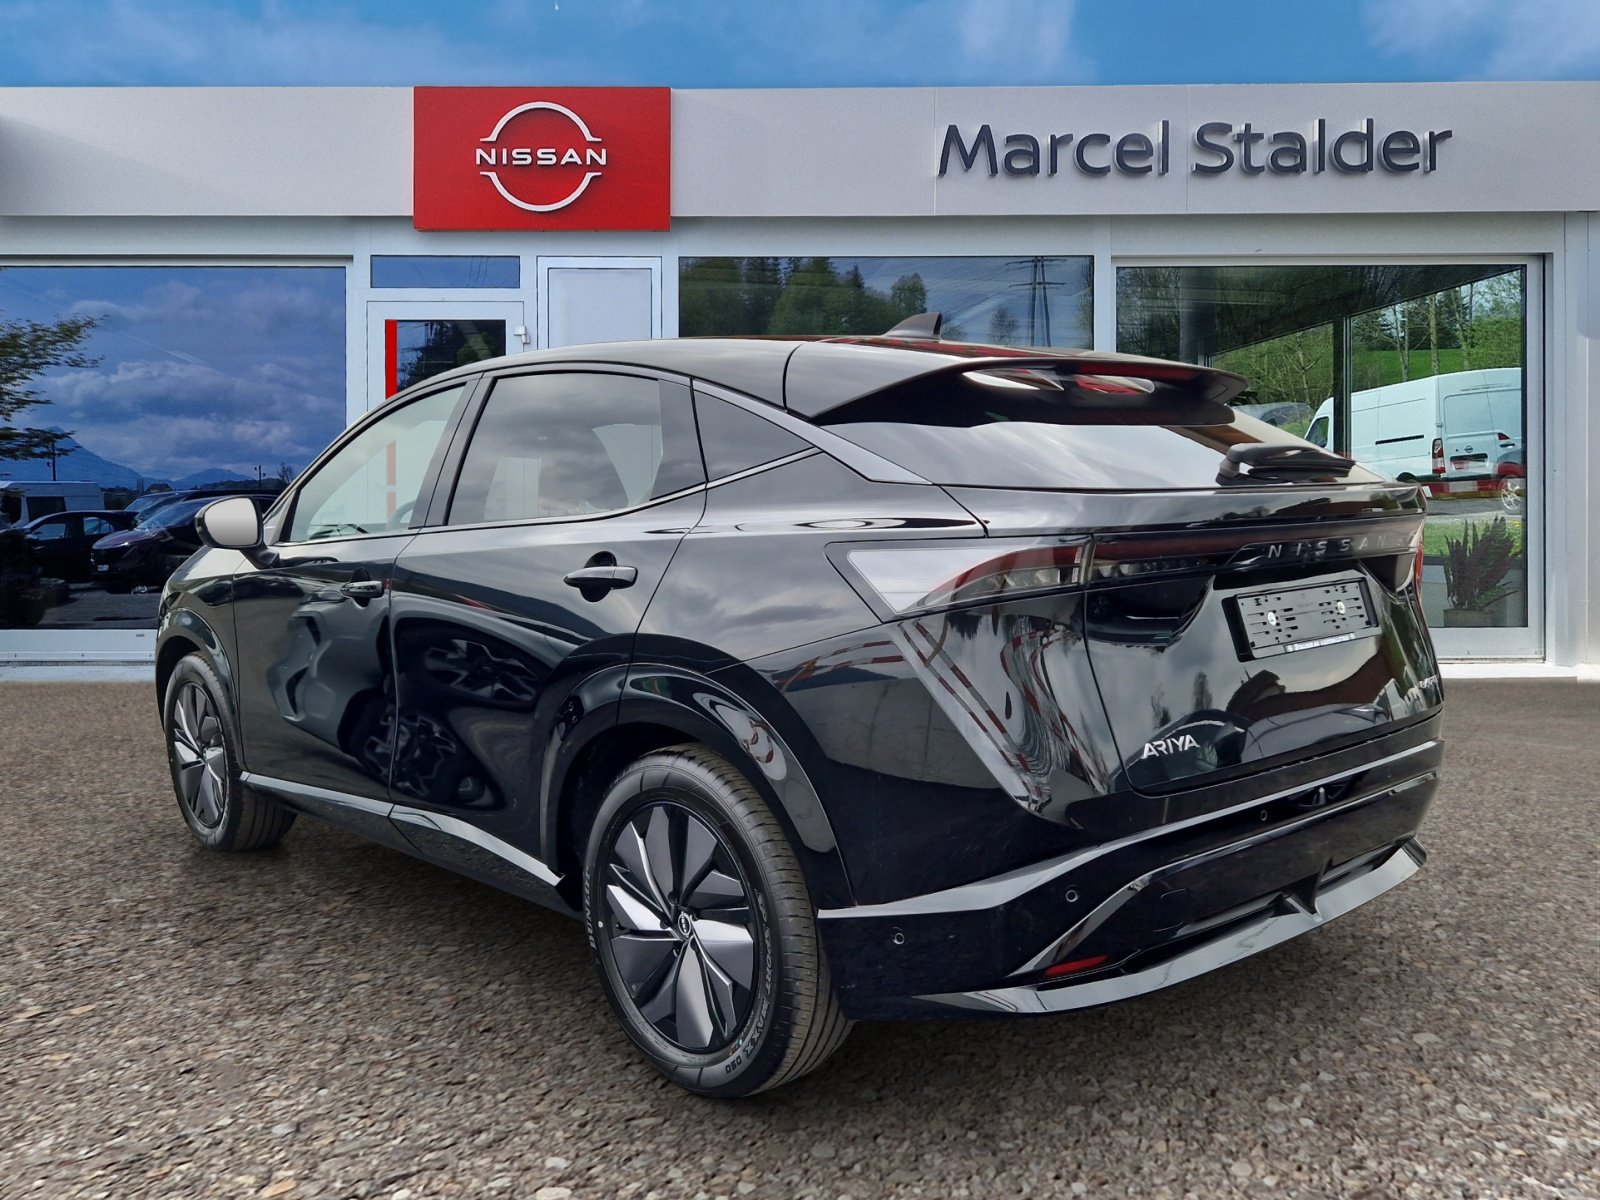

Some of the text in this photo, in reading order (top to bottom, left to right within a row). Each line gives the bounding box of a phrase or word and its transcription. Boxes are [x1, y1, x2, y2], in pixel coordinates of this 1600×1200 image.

[475, 148, 607, 166] NISSAN
[937, 117, 1453, 177] Marcel Stalder
[1267, 535, 1386, 559] NISSAN
[1141, 734, 1200, 760] ARIYA
[764, 925, 774, 995] SPORT
[744, 998, 771, 1057] MAXX
[725, 1055, 743, 1075] 050
